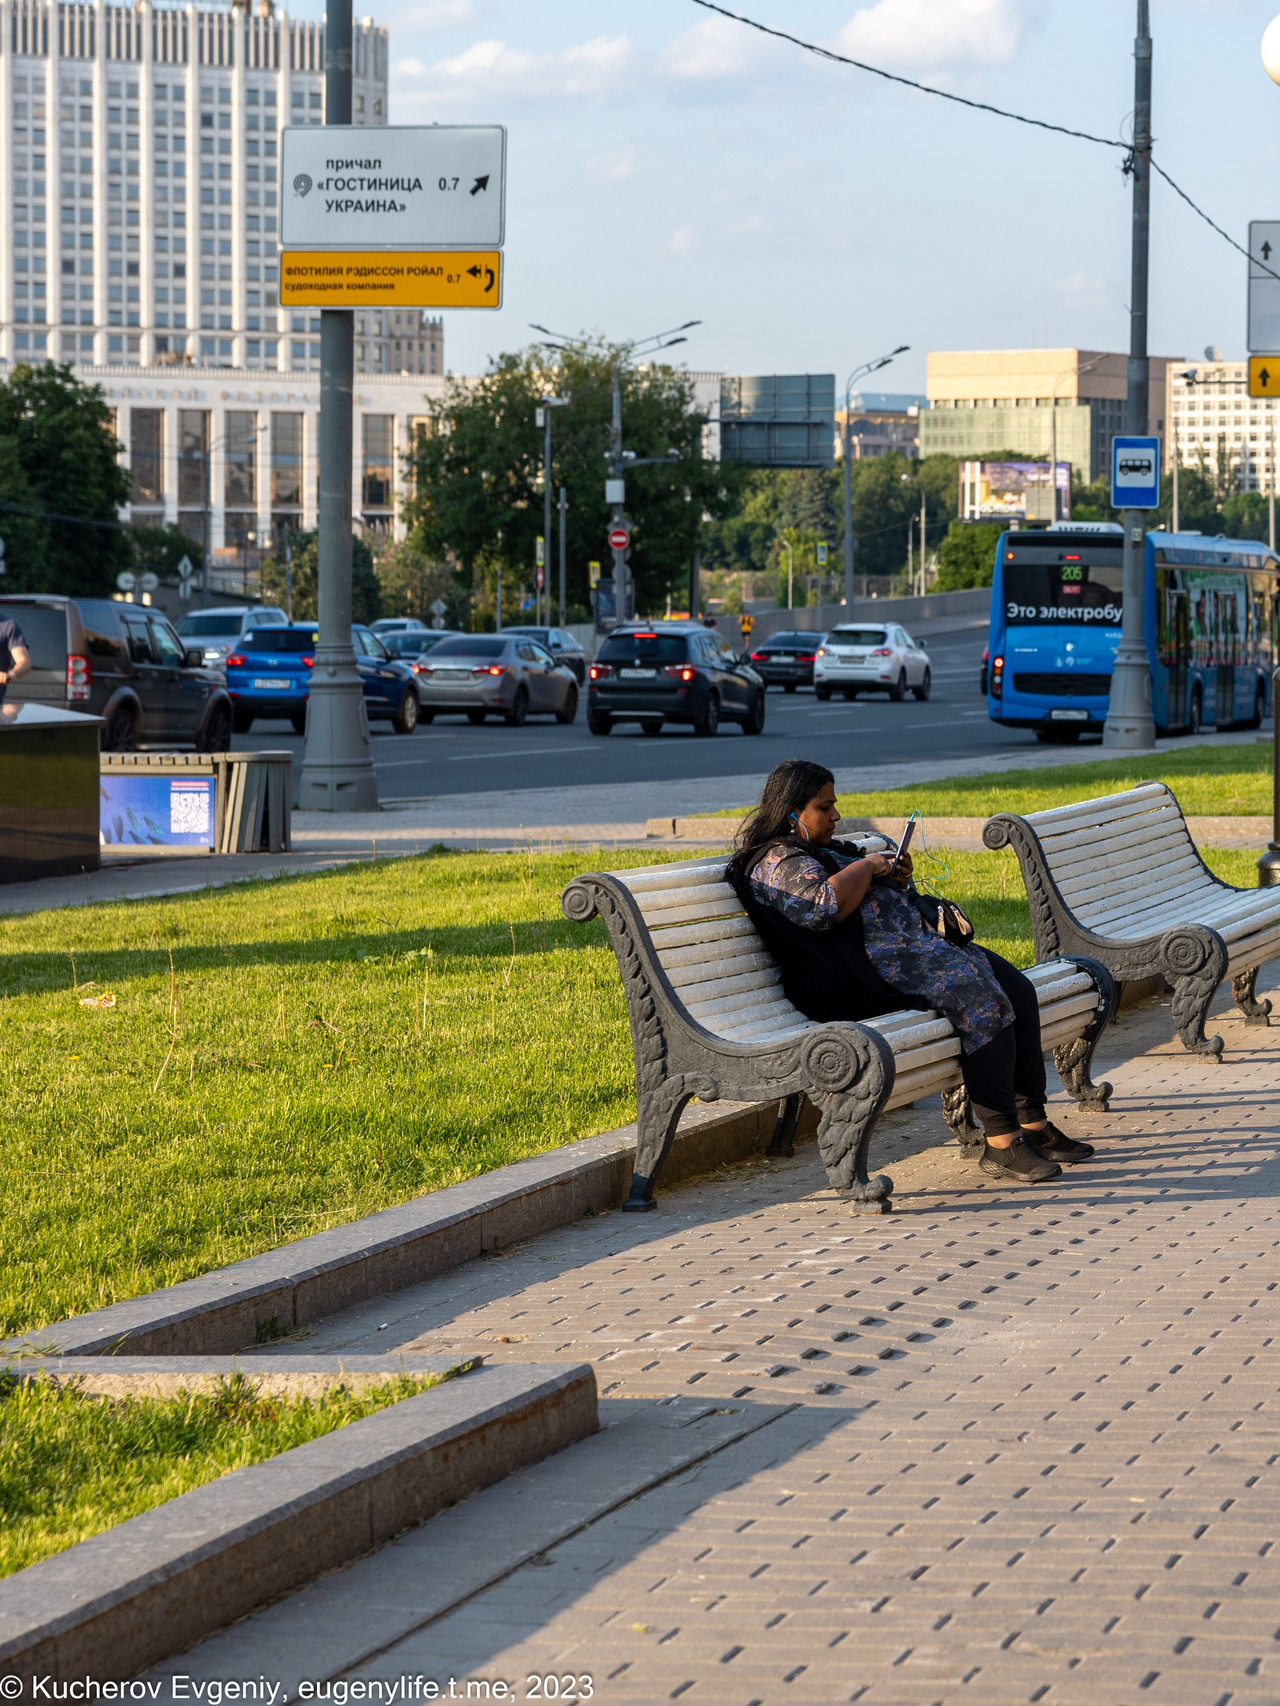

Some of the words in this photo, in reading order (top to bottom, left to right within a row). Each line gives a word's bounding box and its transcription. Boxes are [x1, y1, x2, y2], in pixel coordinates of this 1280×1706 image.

[326, 159, 382, 172] причал
[317, 178, 422, 192] «ГОСТИНИЦА
[438, 178, 460, 191] 0.7
[325, 200, 406, 213] УКРАИНА»
[285, 266, 343, 277] ФЛОТИЛИЯ
[346, 266, 404, 278] РЭДИССОН
[407, 265, 444, 277] РОЙАЛ
[447, 274, 461, 284] 0.7
[285, 283, 344, 292] судоходная
[346, 283, 395, 291] компания
[1062, 566, 1082, 581] 205
[1006, 602, 1037, 618] Это
[1040, 603, 1123, 623] электробу
